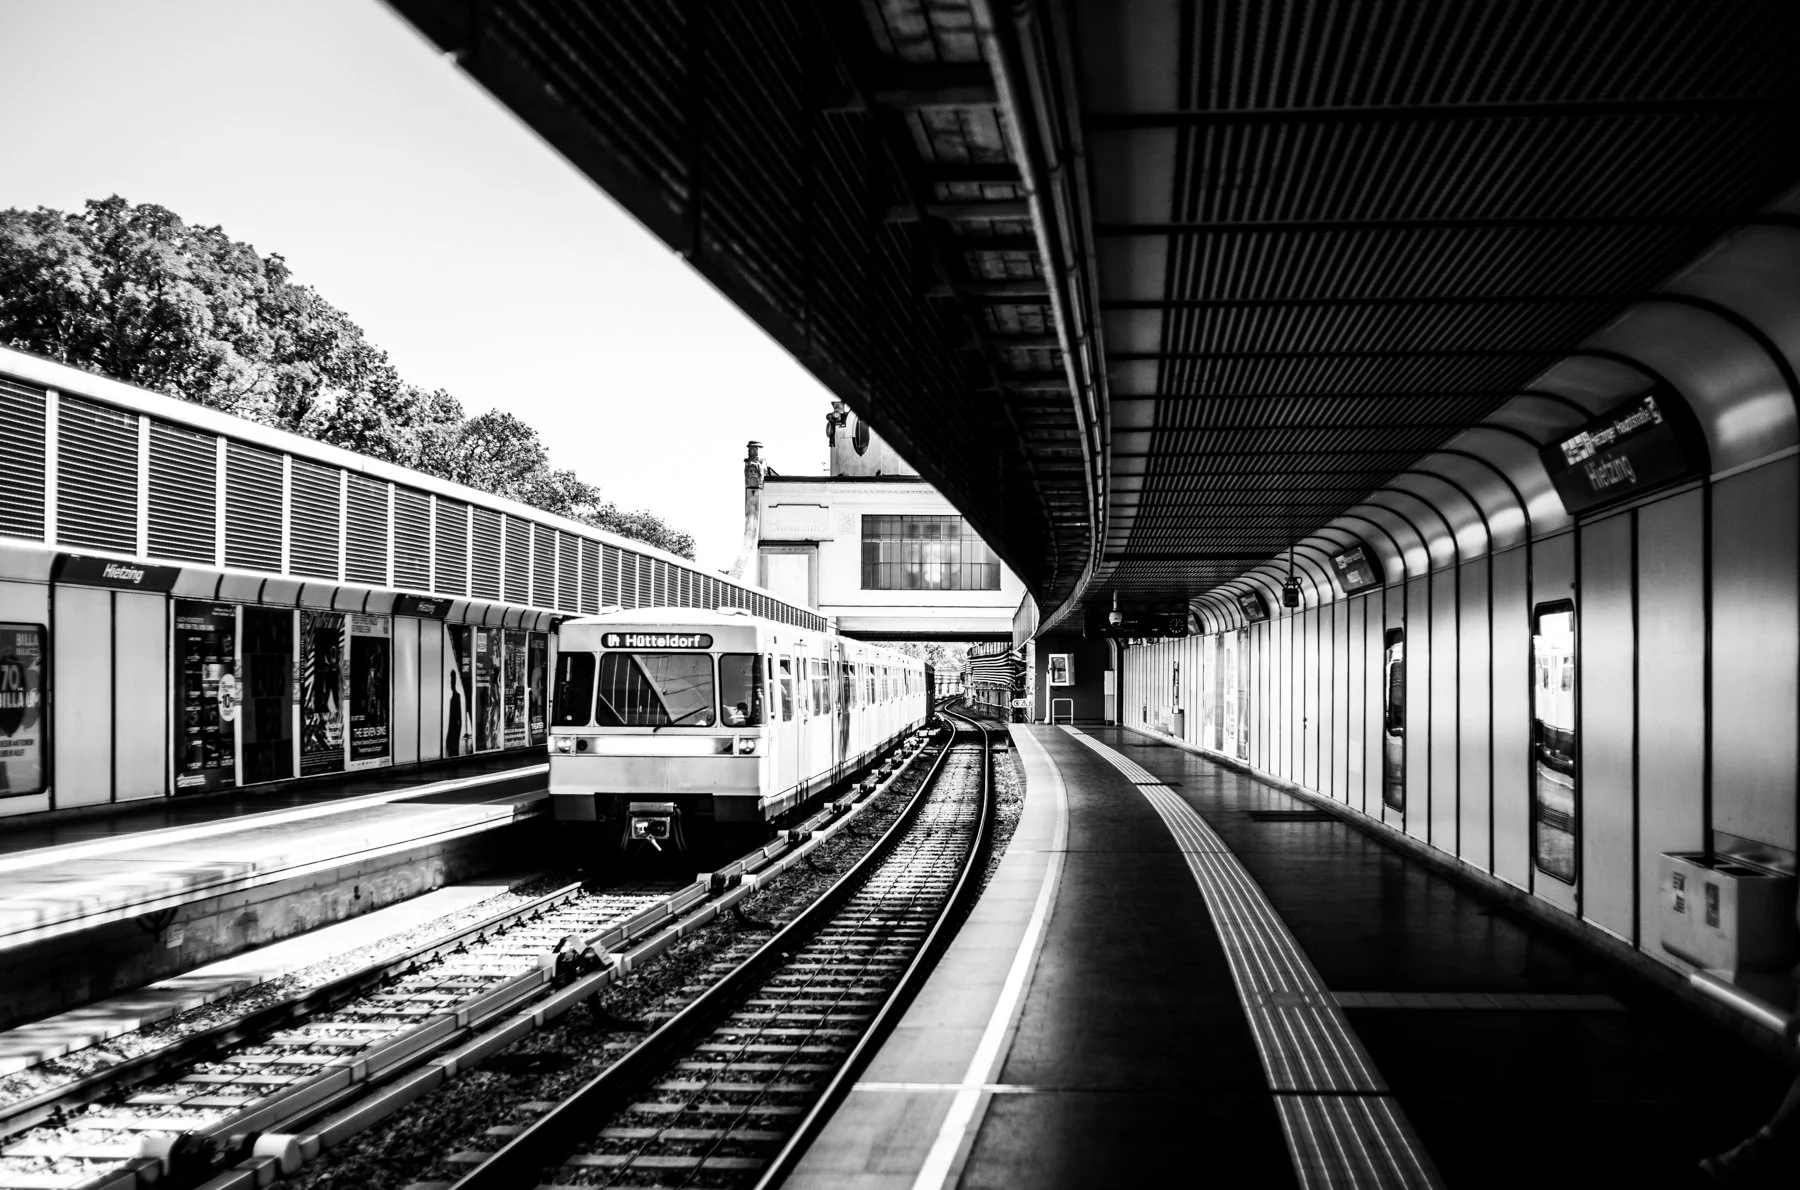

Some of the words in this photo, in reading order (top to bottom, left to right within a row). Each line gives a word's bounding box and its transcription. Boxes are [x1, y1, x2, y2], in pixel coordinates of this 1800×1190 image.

[1585, 454, 1637, 490] Hietzing
[103, 563, 144, 584] Hietzing
[16, 633, 39, 646] BILLA
[625, 635, 700, 647] Hütteldorf
